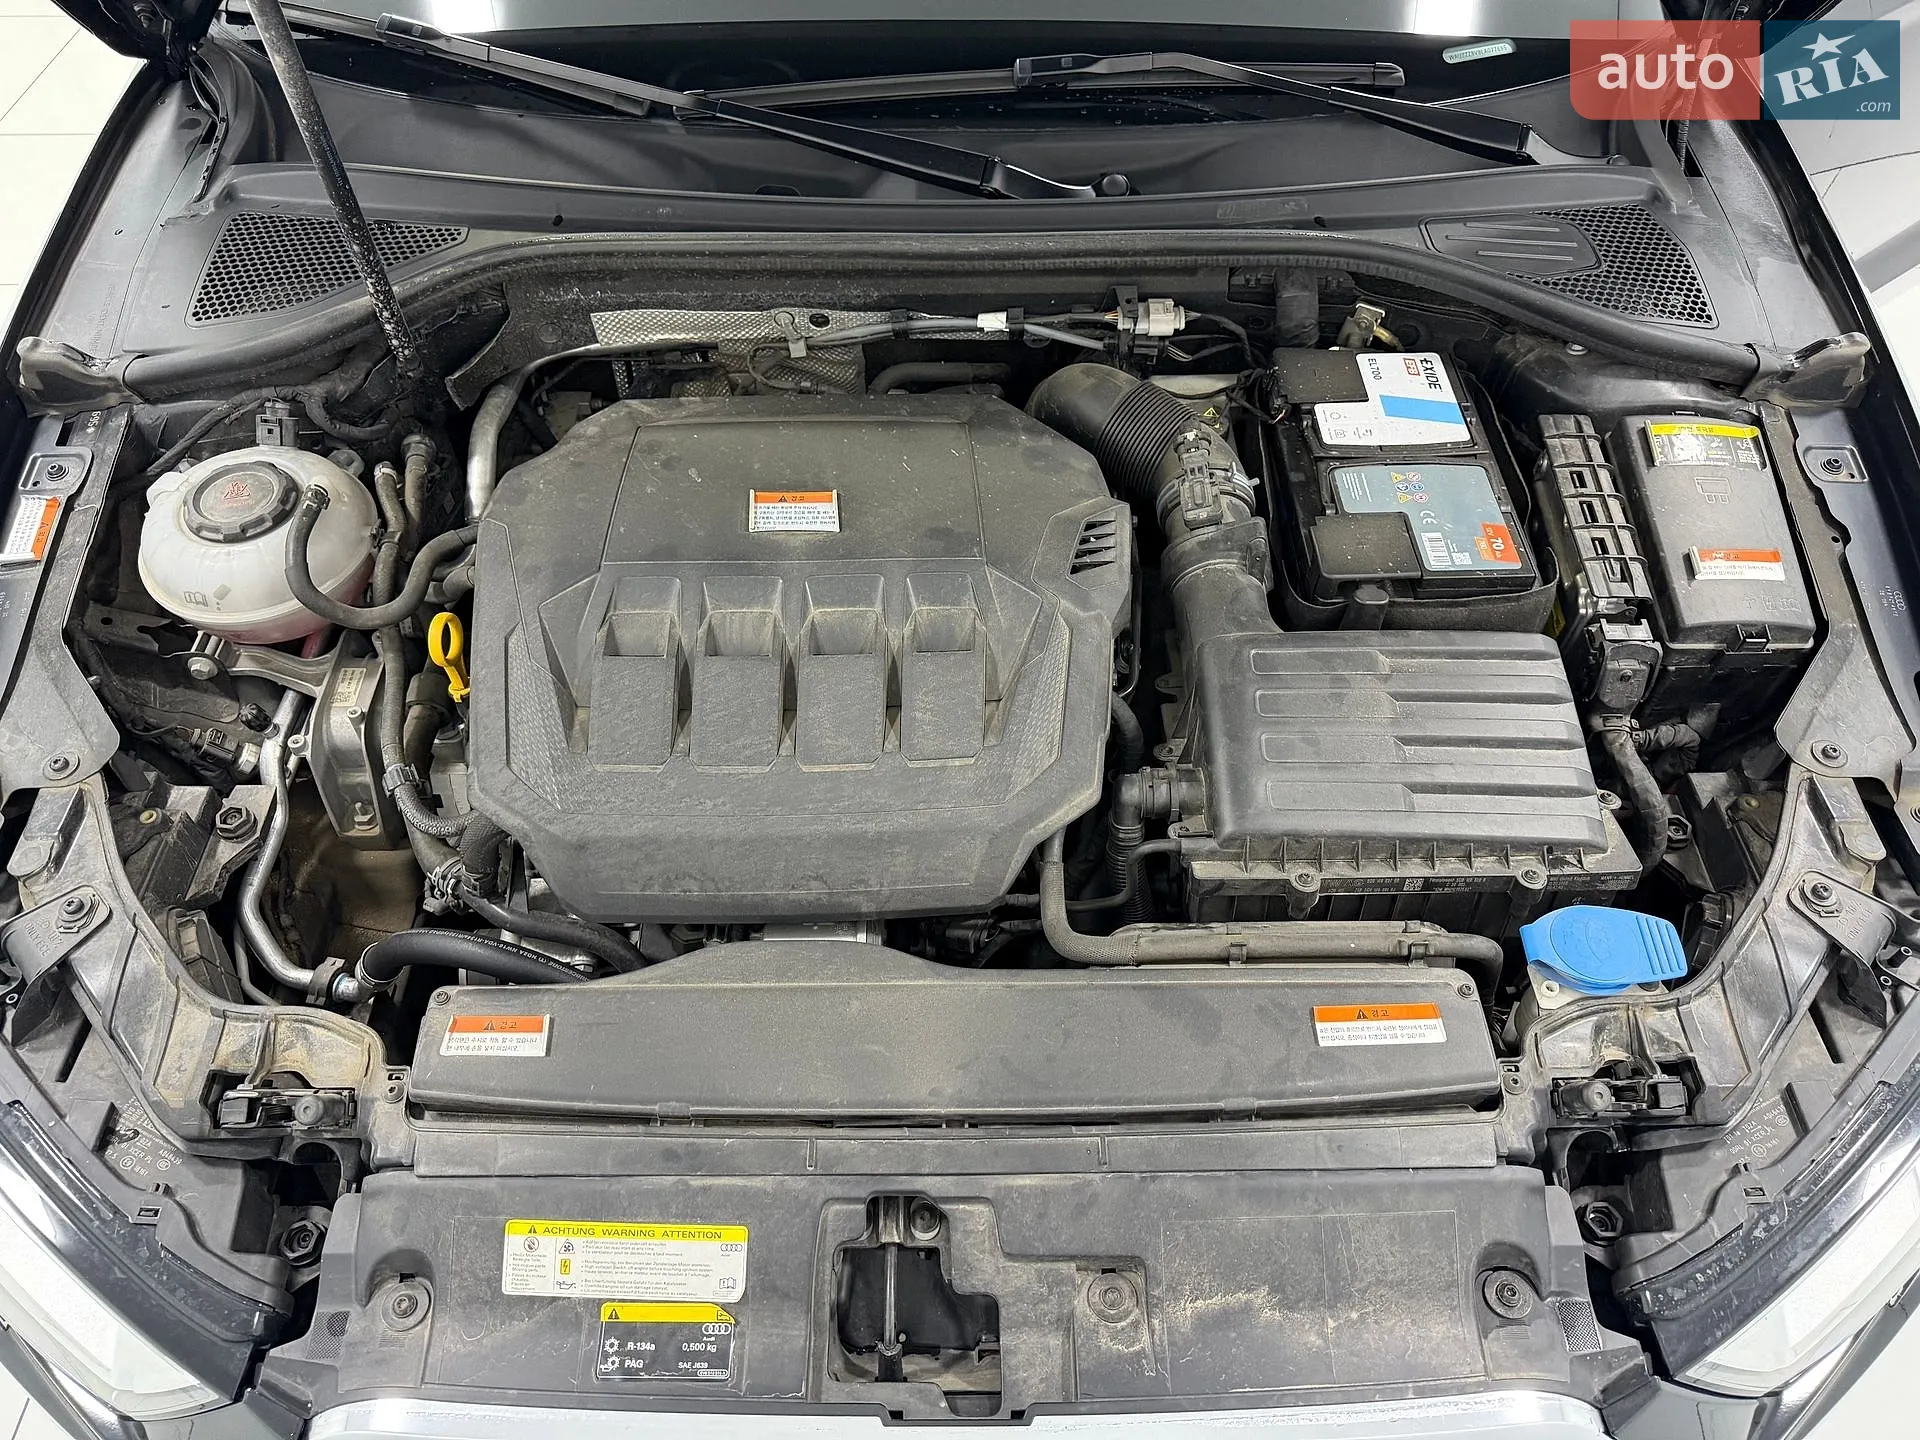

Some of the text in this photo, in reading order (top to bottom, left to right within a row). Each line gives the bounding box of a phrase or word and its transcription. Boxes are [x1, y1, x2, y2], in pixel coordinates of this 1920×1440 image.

[1367, 358, 1382, 380] EL700
[1420, 358, 1443, 392] EXIDE
[1490, 537, 1505, 551] 70
[543, 1226, 722, 1239] ACHTUNG WARNING ATTENTION
[627, 1341, 717, 1352] R-134a 0,500 kg
[624, 1359, 644, 1368] PAG
[678, 1361, 692, 1369] SAE
